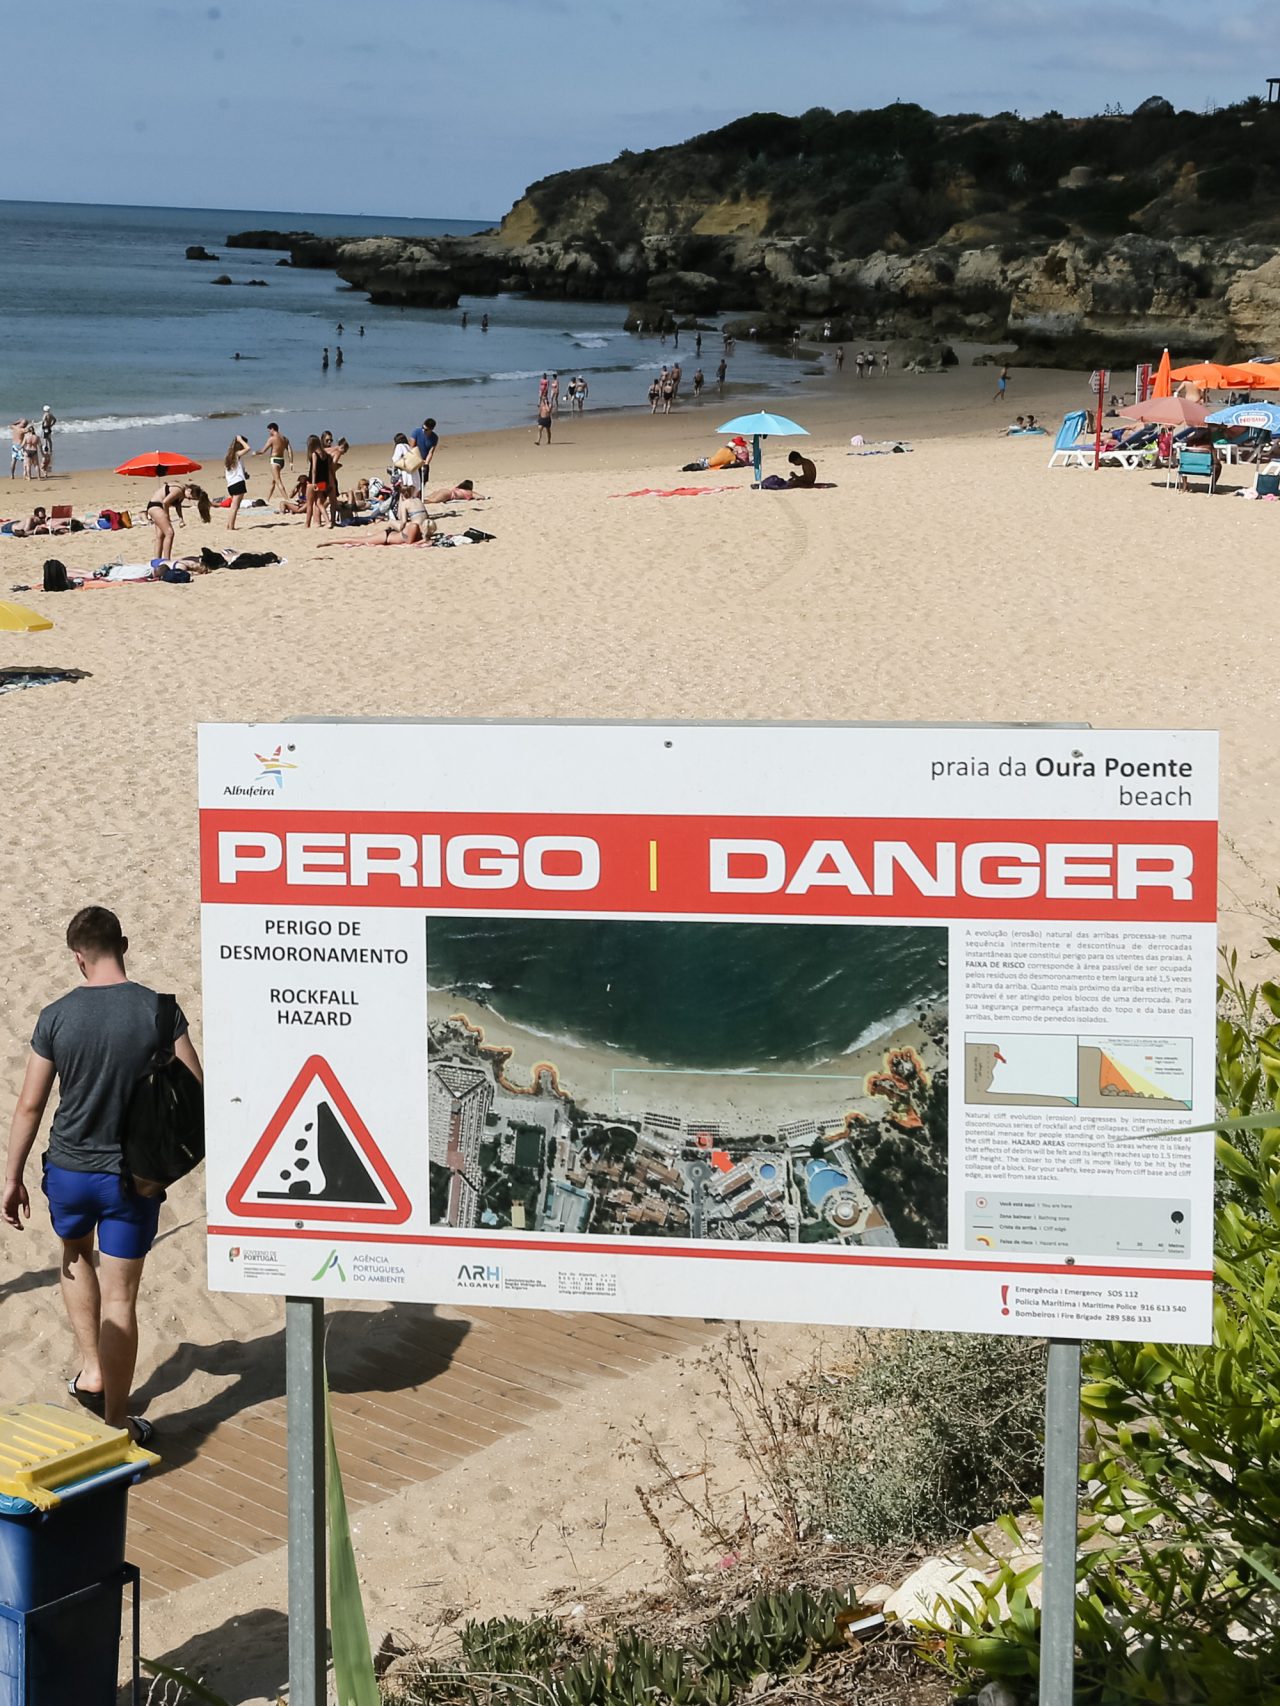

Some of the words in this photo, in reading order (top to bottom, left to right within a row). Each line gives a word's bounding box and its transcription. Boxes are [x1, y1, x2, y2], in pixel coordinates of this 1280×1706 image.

[930, 757, 990, 780] praia
[998, 756, 1026, 777] da
[1036, 757, 1096, 778] Oura
[1105, 758, 1193, 778] Poente
[222, 785, 276, 798] Albufeira
[1119, 786, 1192, 807] beach
[218, 831, 600, 890] PERIGO
[708, 838, 1194, 900] DANGER
[265, 919, 331, 936] PERIGO
[338, 920, 361, 937] DE
[220, 944, 408, 965] DESMORONAMENTO
[965, 960, 988, 968] FAIXA
[1002, 961, 1026, 969] RISCO
[270, 988, 359, 1006] ROCKFALL
[276, 1009, 352, 1027] HAZARD
[1011, 1138, 1041, 1146] HAZARD
[1042, 1139, 1066, 1147] AREAS
[353, 1254, 389, 1263] AGÊNCIA
[353, 1264, 405, 1274] PORTUGUESA
[458, 1264, 500, 1281] ARH
[353, 1274, 366, 1282] DO
[368, 1274, 405, 1284] AMBIENTE
[1016, 1286, 1058, 1295] Emergência
[1064, 1288, 1102, 1298] Emergency
[1124, 1290, 1138, 1298] 112
[1016, 1310, 1055, 1318] Bombeiros
[1076, 1314, 1102, 1322] Brigade
